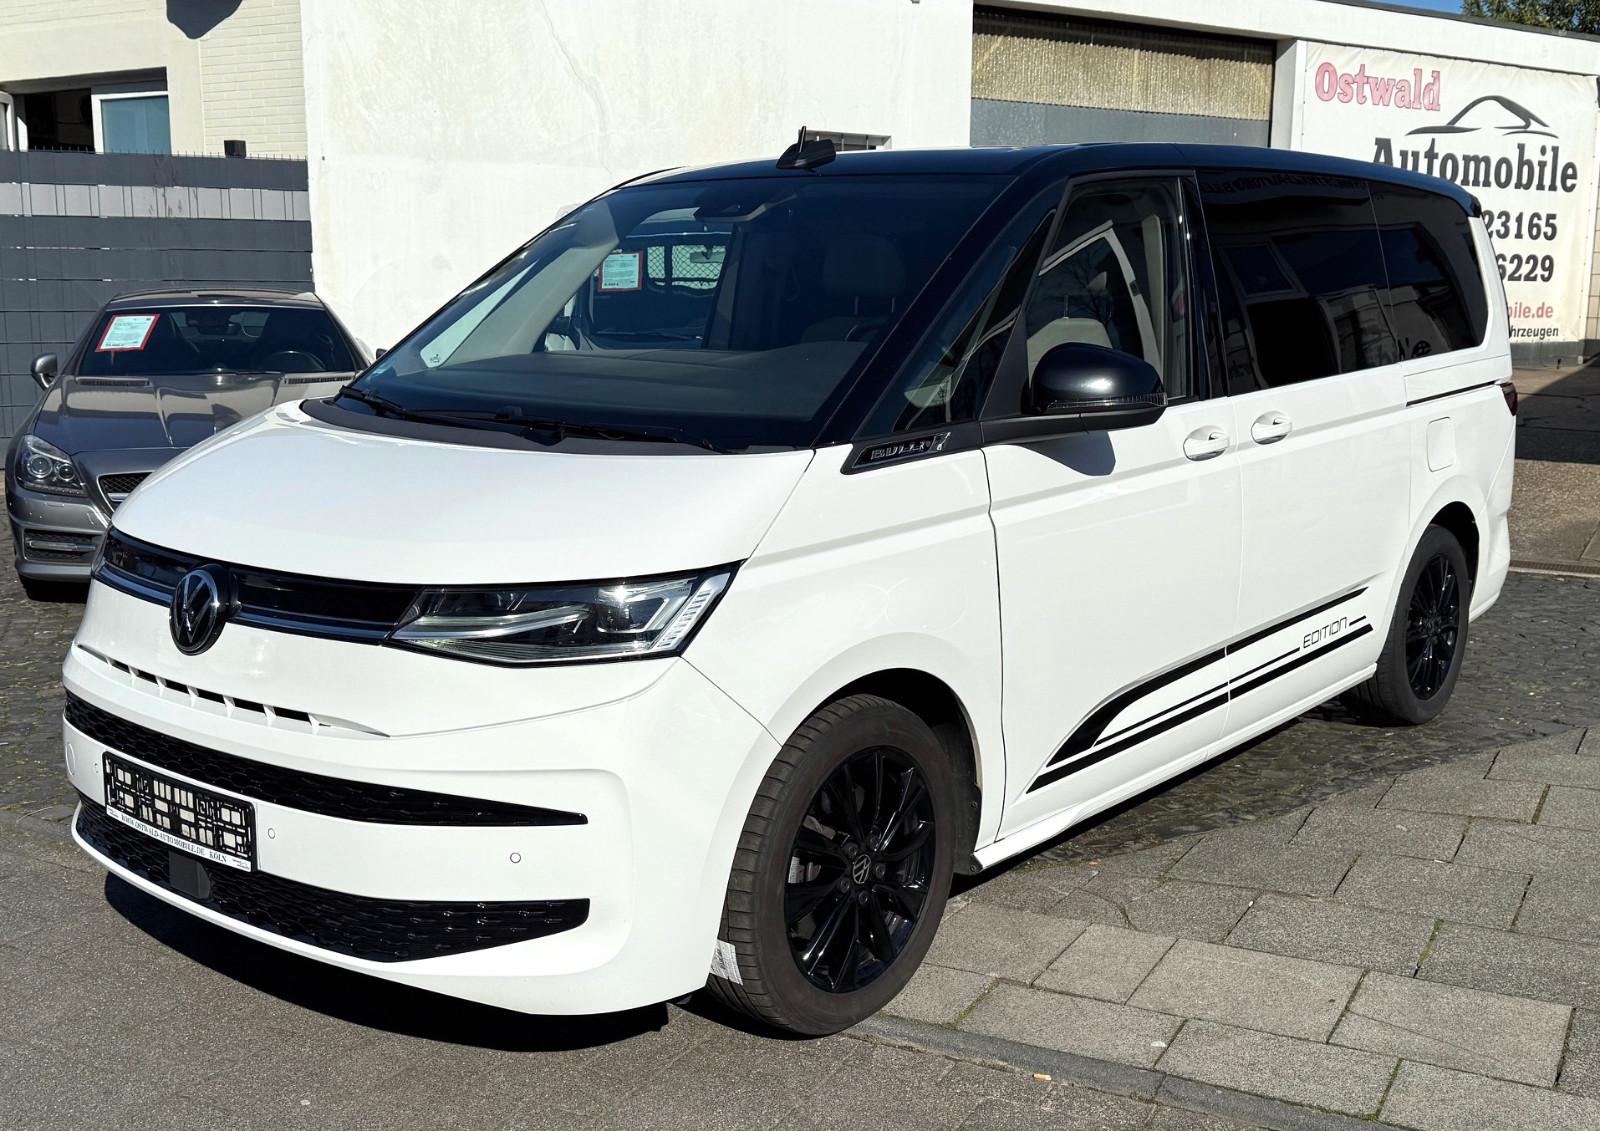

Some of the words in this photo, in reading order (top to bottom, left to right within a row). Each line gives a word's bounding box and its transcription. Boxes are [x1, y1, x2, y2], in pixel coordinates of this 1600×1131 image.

[1314, 62, 1441, 111] Ostwald
[1373, 137, 1578, 193] Automobile
[1482, 210, 1557, 241] 23165
[1496, 253, 1554, 283] 6229
[1303, 616, 1347, 649] EDITION
